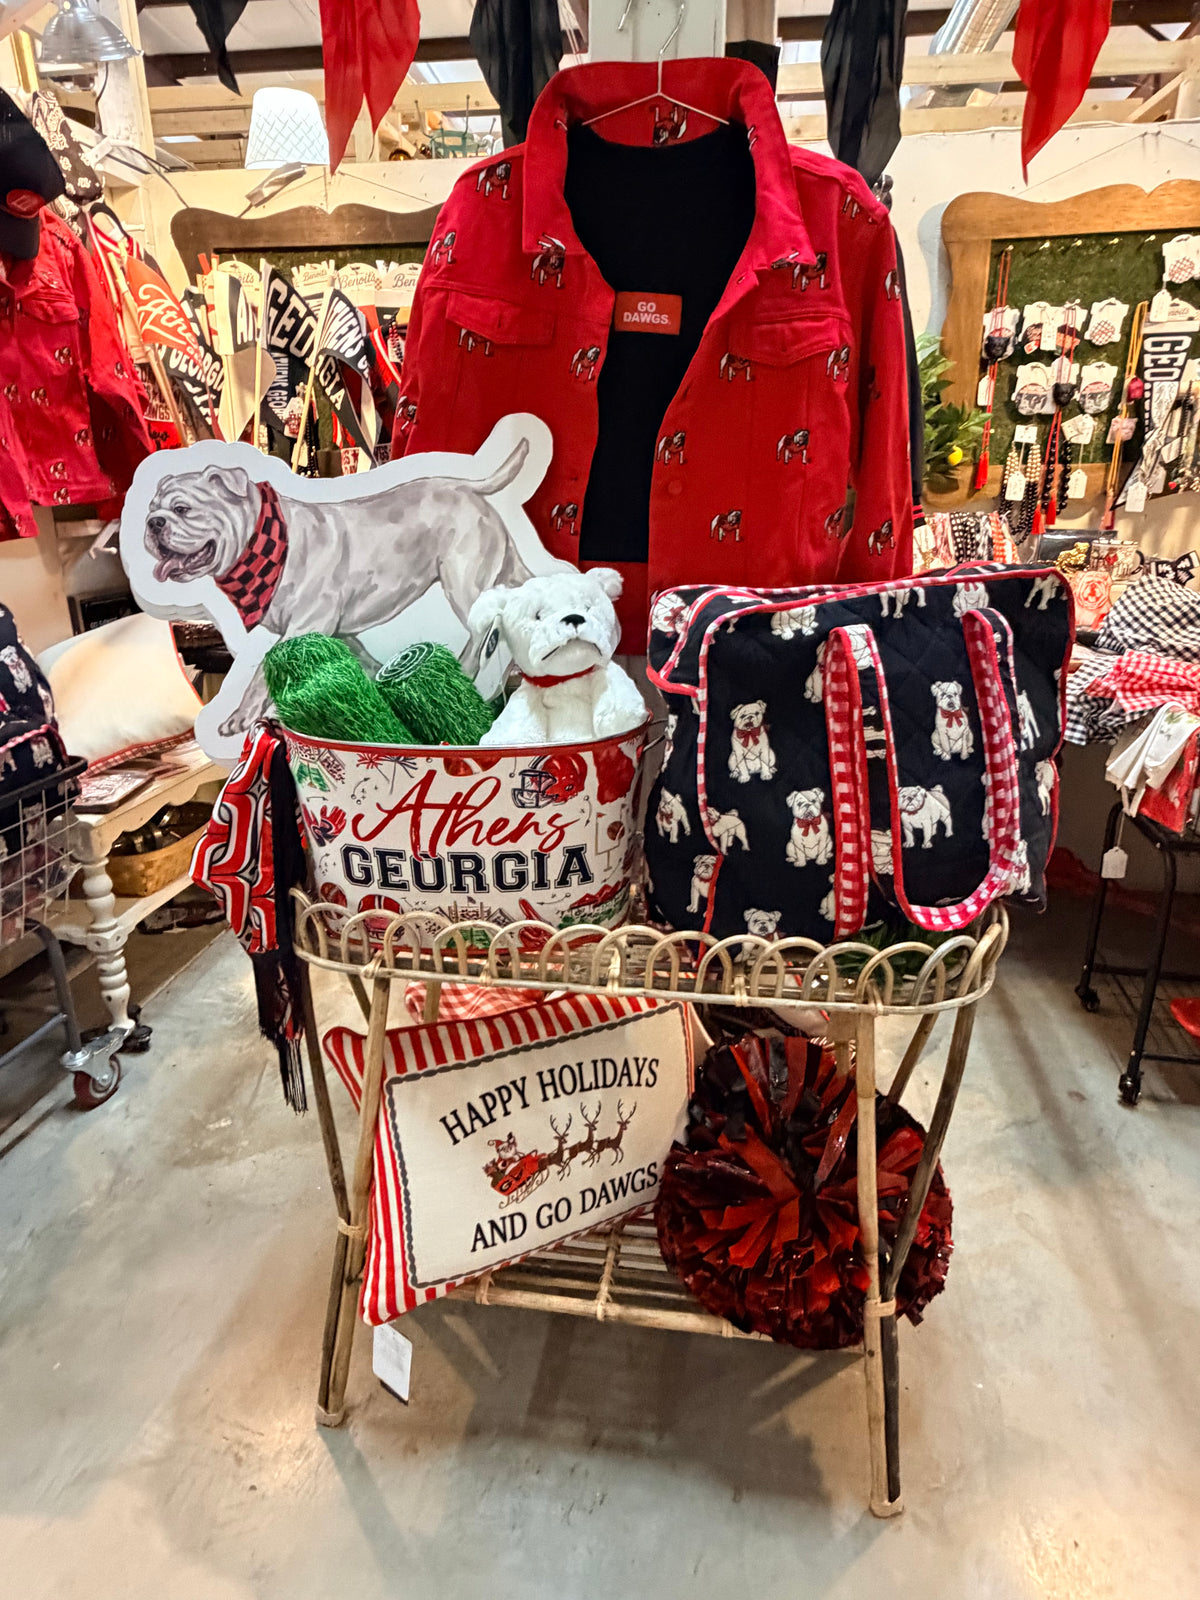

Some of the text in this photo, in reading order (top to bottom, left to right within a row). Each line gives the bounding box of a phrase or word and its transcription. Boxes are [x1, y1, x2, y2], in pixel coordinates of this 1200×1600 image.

[340, 272, 376, 289] Benoit's
[392, 273, 416, 289] Ben
[623, 311, 669, 325] DAWGS
[637, 301, 657, 313] GO
[1143, 335, 1192, 383] GEO
[351, 769, 580, 862] Athens
[340, 843, 594, 894] GEORGIA
[439, 1057, 660, 1146] HAPPY HOLIDAYS
[470, 1161, 658, 1253] AND GO DAWGS
